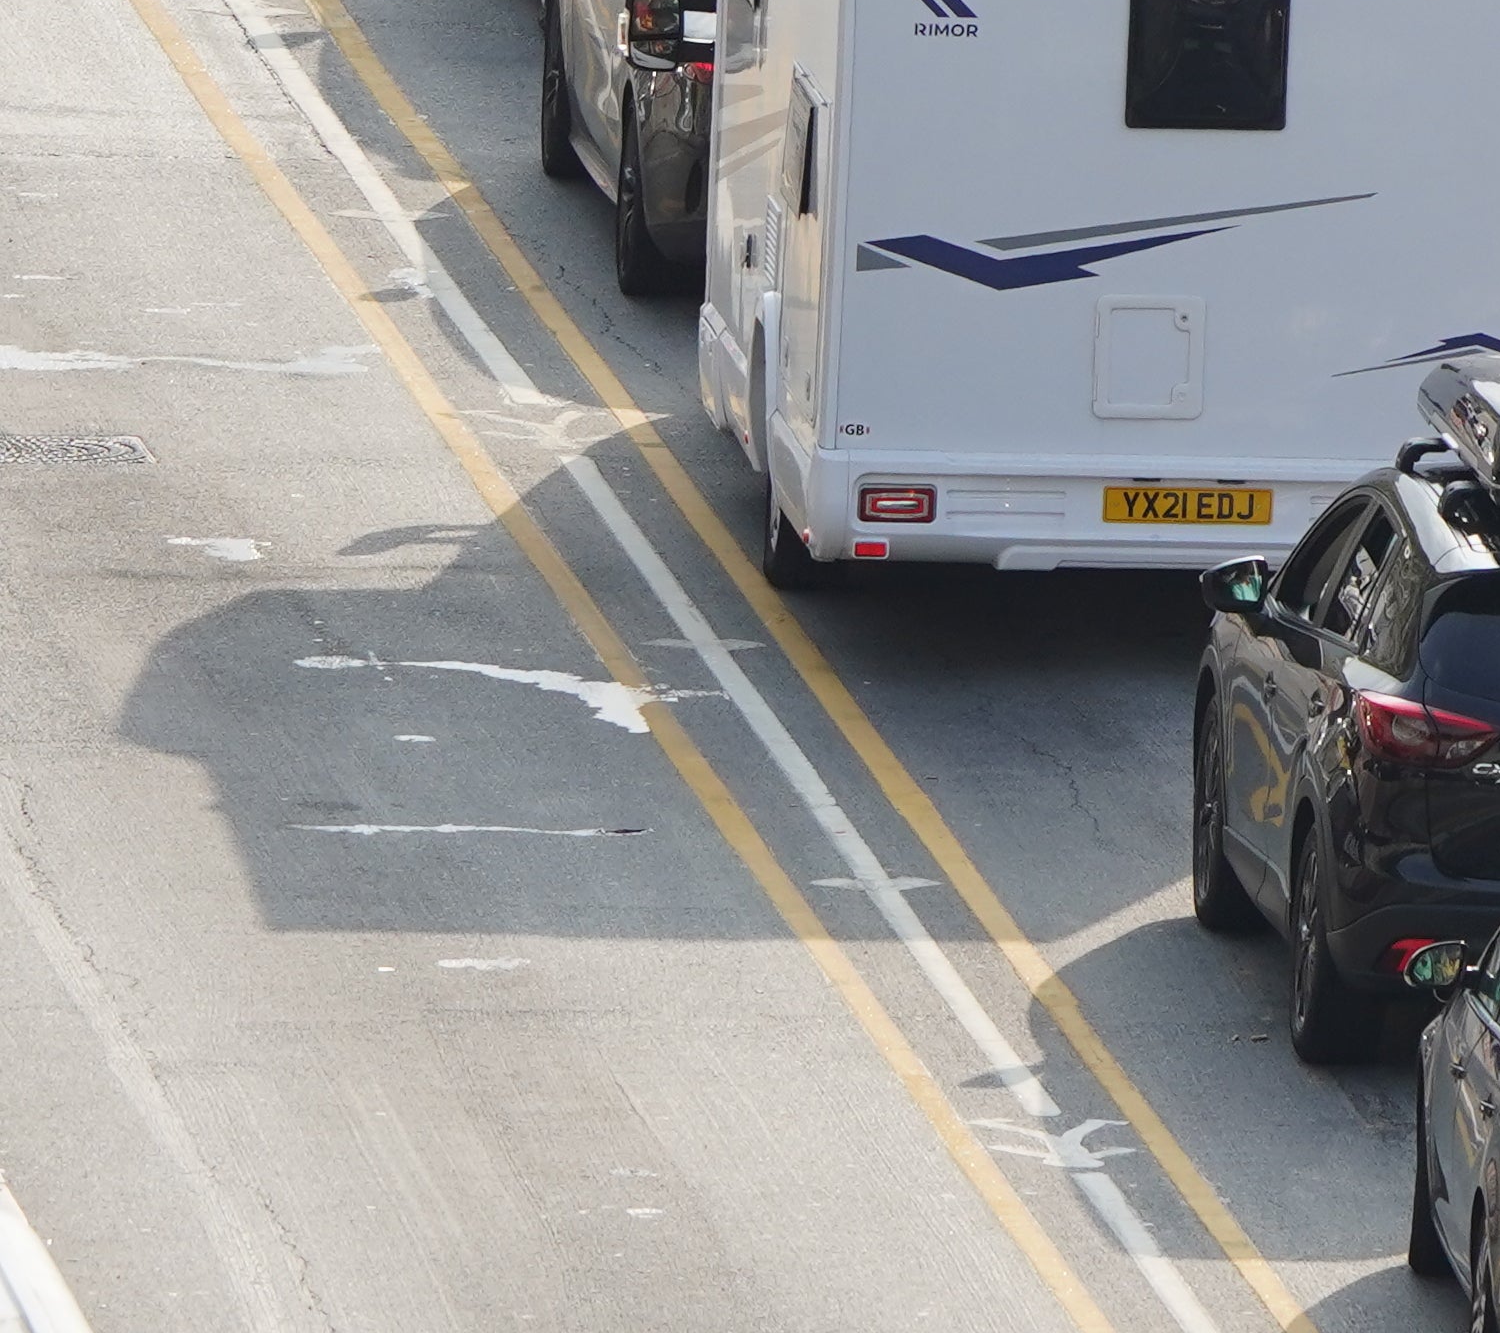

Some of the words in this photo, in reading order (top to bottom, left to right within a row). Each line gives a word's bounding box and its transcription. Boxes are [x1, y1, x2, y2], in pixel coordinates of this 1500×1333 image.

[914, 23, 978, 38] RIMOR
[845, 424, 864, 436] GB
[1122, 492, 1186, 519] YX21
[1195, 493, 1254, 521] EDJ
